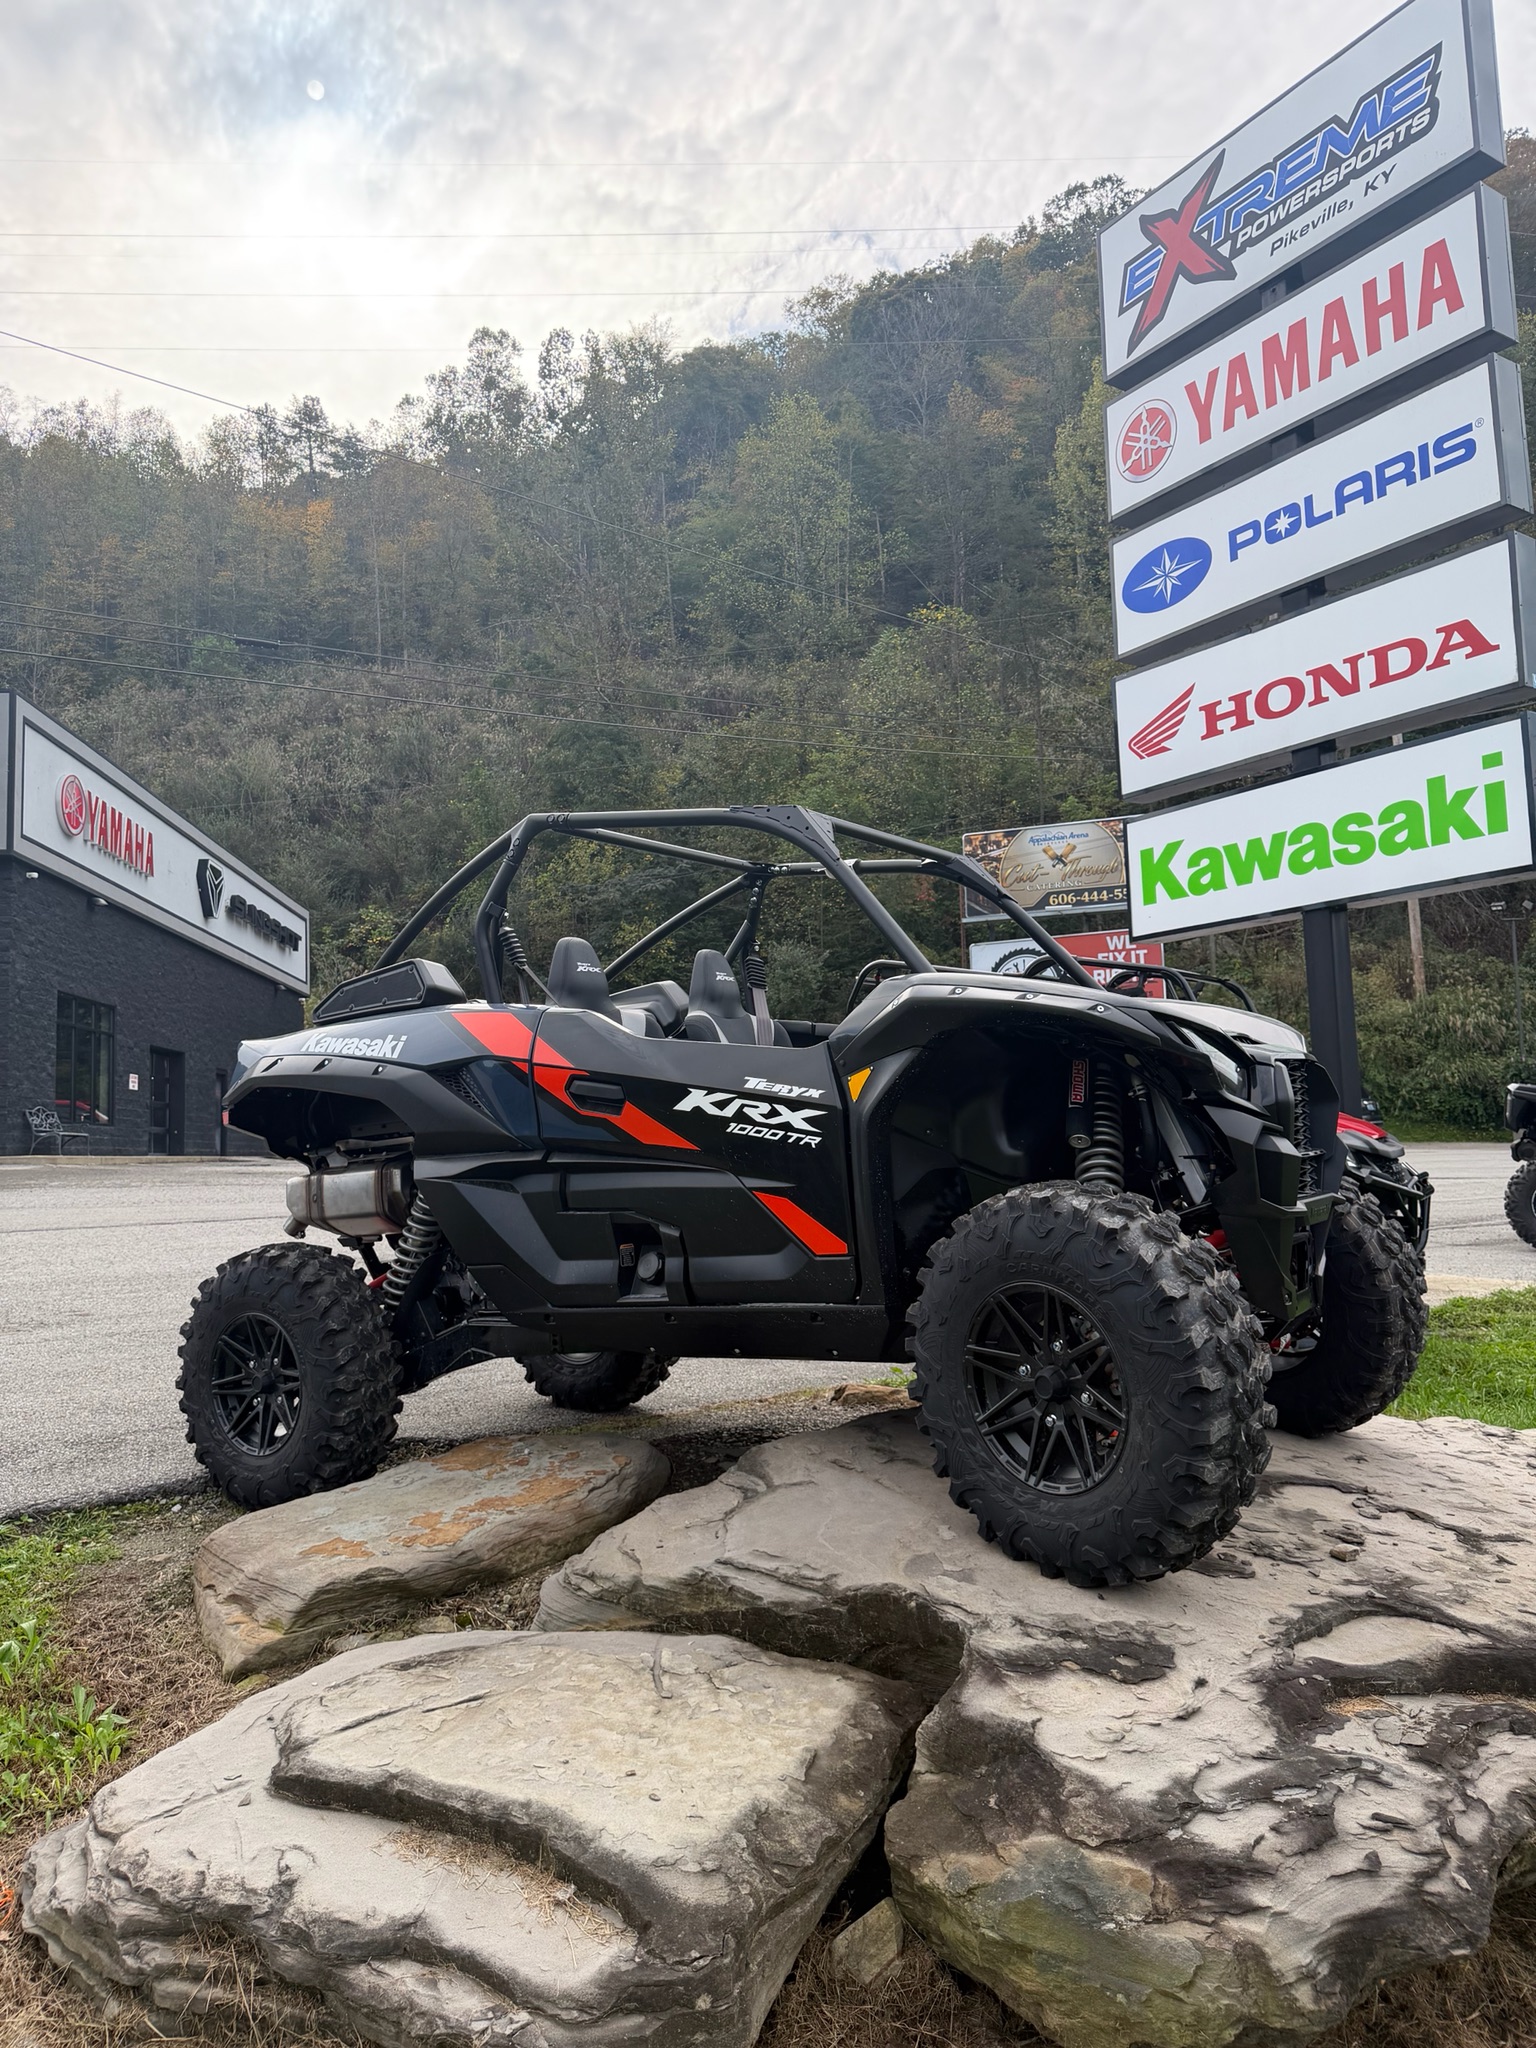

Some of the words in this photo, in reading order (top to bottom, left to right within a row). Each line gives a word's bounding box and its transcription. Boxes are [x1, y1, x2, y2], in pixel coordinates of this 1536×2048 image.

[1120, 44, 1440, 354] EXTREME
[1235, 107, 1432, 249] POWERSPORTS
[1270, 197, 1354, 257] Pikeville,
[1363, 163, 1398, 198] KY
[1184, 238, 1465, 445] YAMAHA
[1228, 422, 1477, 562] POLARIS
[1198, 619, 1500, 741] HONDA
[85, 789, 155, 877] YAMAHA
[1027, 833, 1068, 847] Appalachian
[1068, 831, 1090, 840] Arena
[1139, 751, 1509, 906] Kawasaki
[1026, 880, 1082, 891] CATERING
[300, 1032, 408, 1059] Kawasaki
[1071, 1060, 1086, 1103] SHOWA
[672, 1087, 829, 1134] KRX
